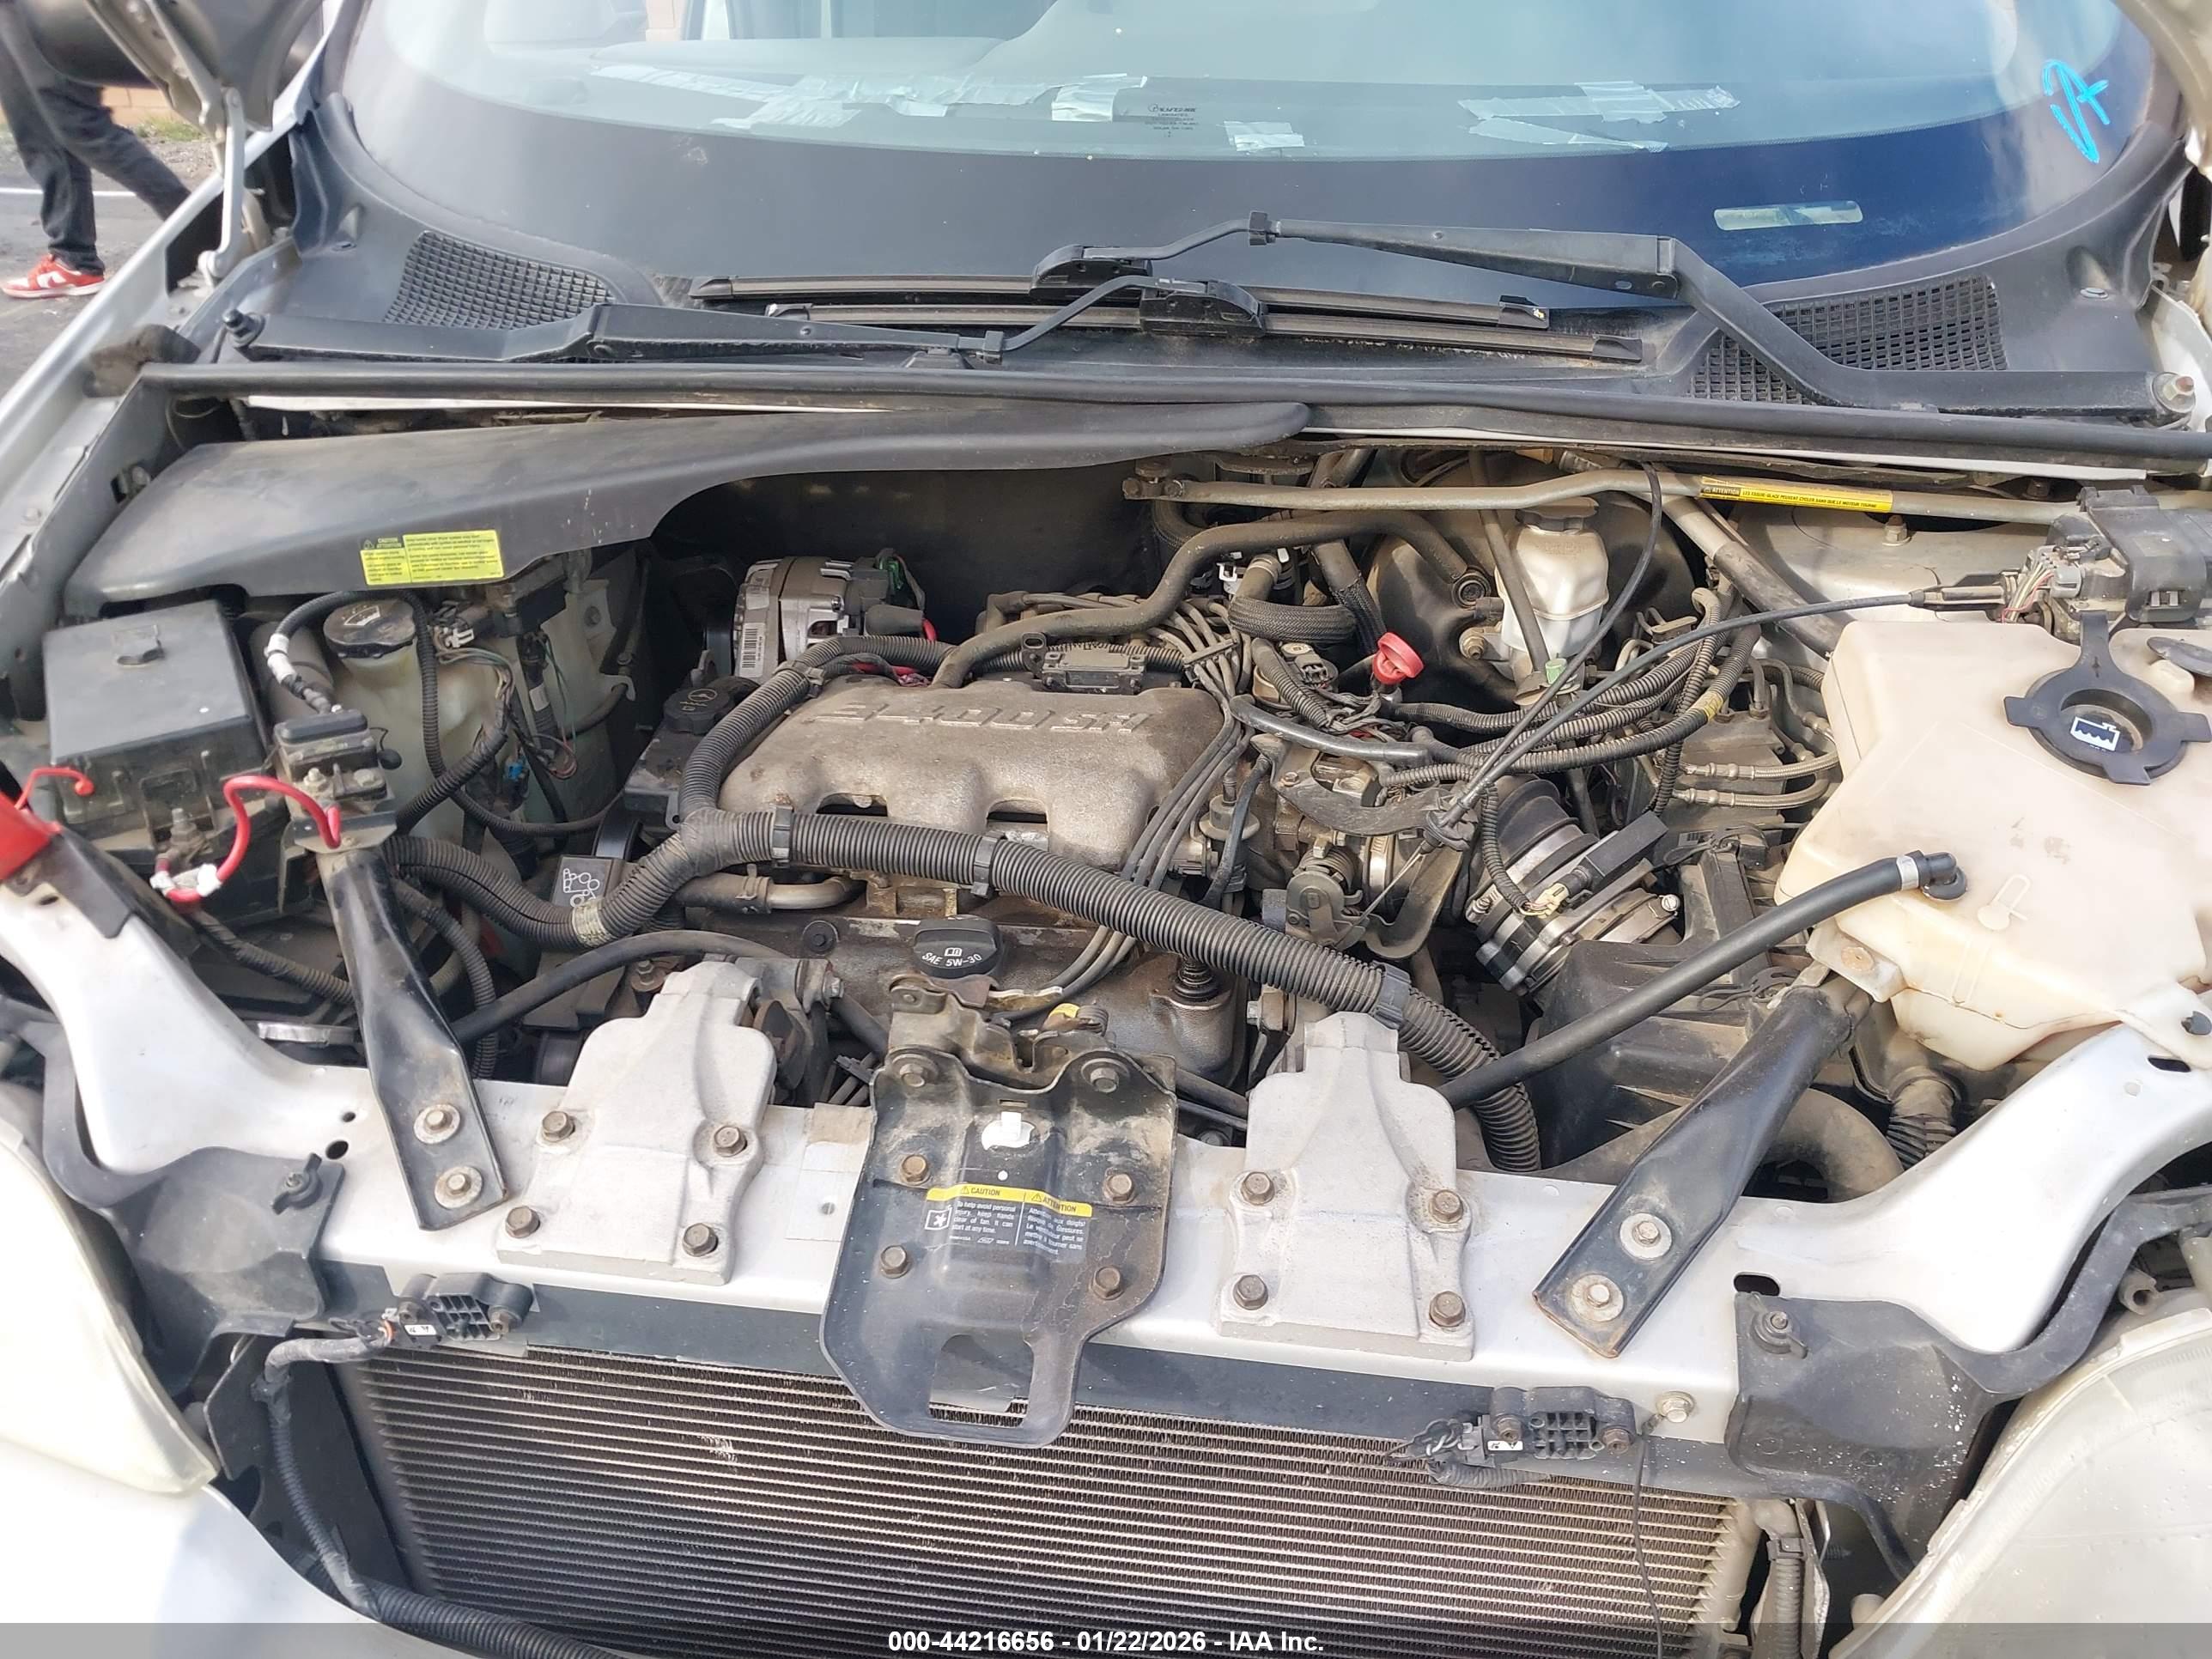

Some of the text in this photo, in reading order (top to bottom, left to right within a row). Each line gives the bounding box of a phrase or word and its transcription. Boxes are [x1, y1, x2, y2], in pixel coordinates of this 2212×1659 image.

[921, 952, 982, 967] SAE 5W-30
[970, 1187, 1000, 1196] CAUTION
[1042, 1197, 1077, 1212] ATTENTION
